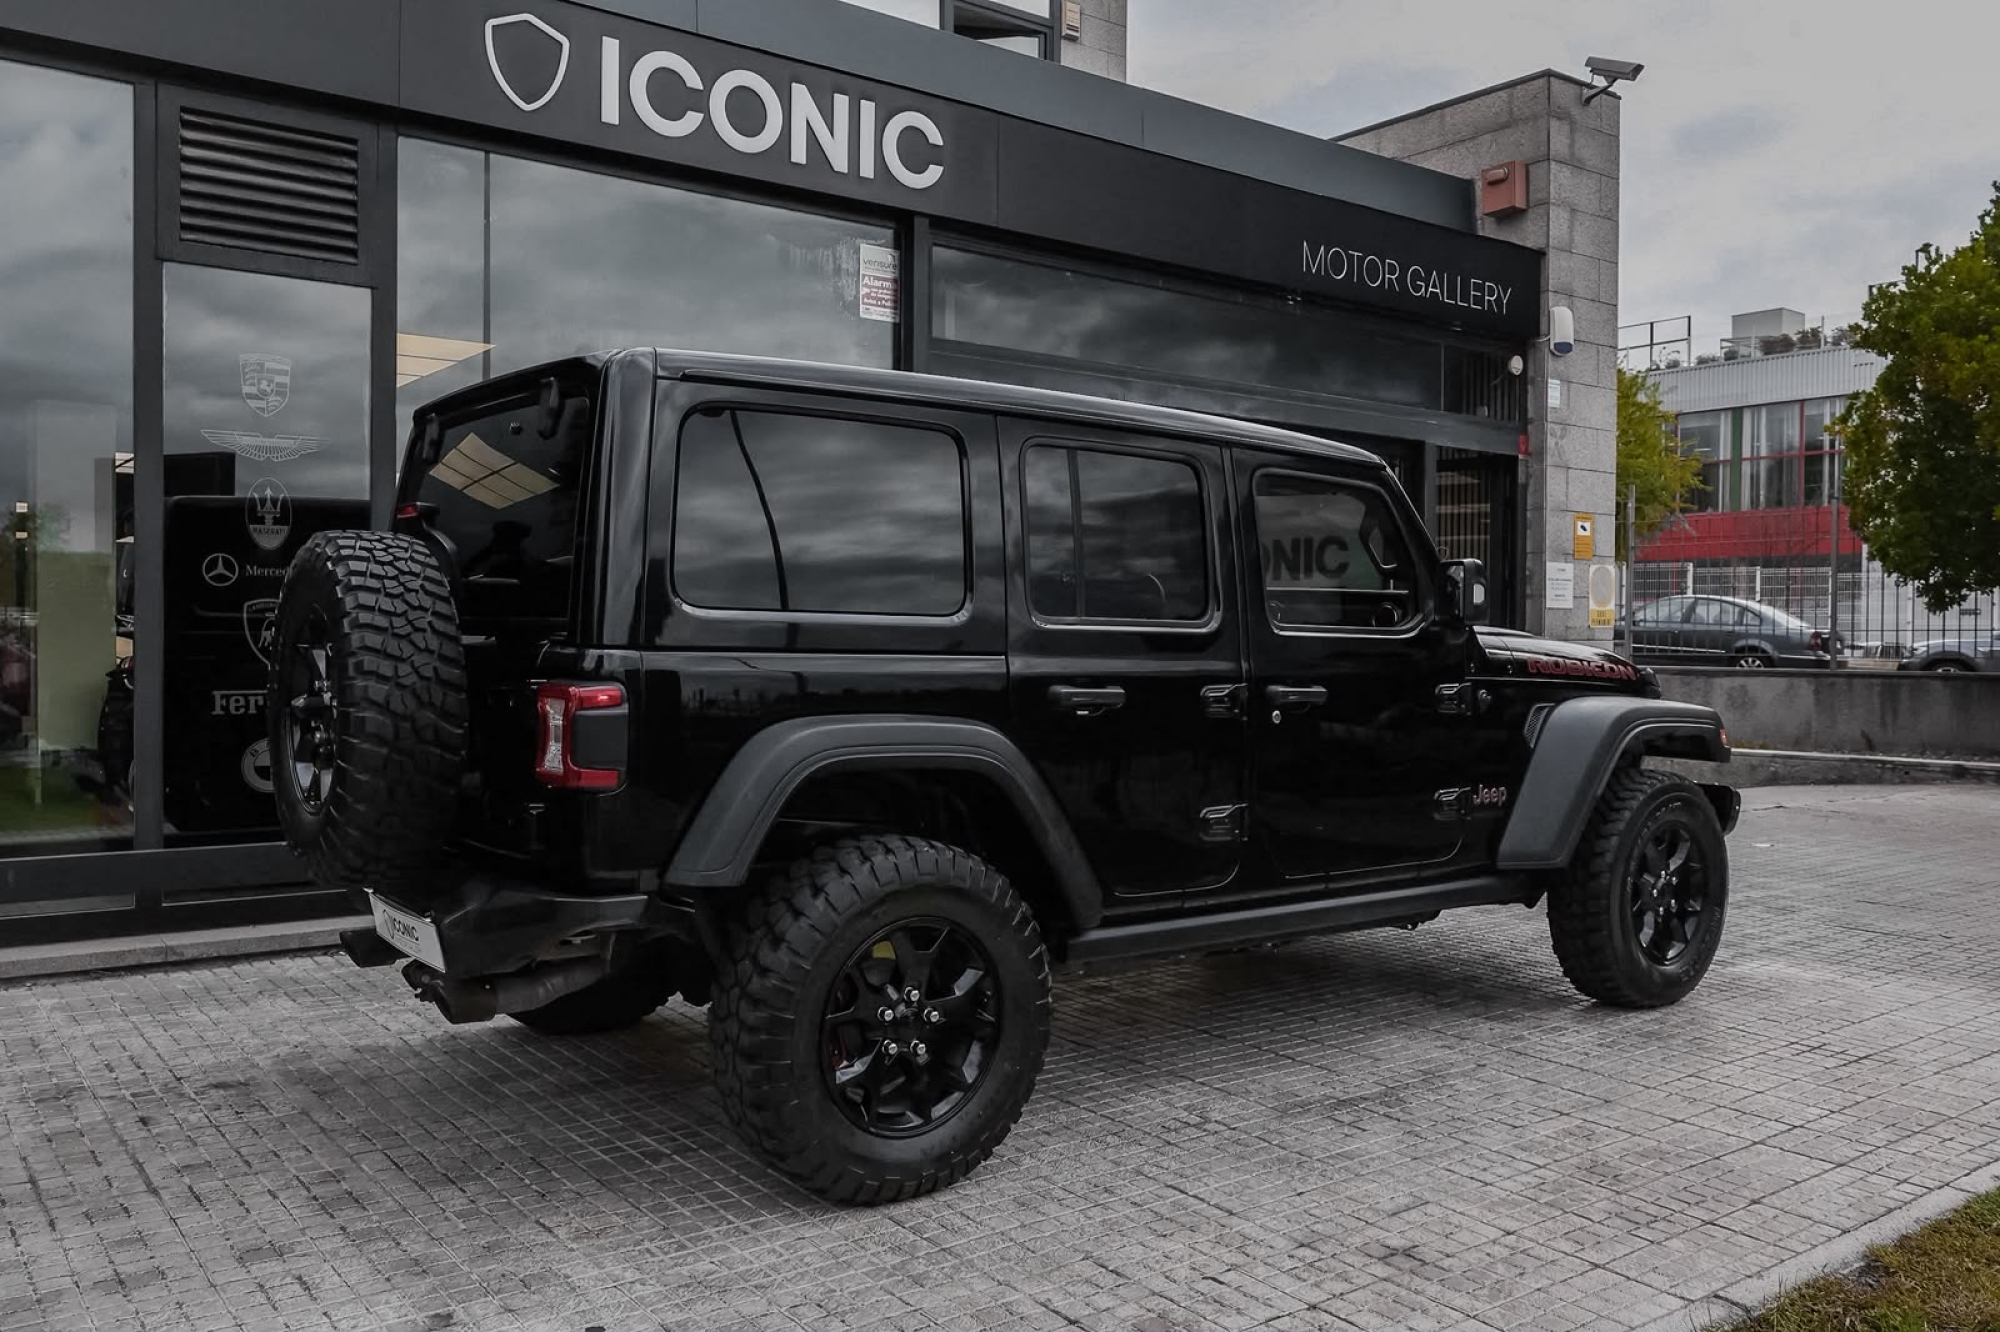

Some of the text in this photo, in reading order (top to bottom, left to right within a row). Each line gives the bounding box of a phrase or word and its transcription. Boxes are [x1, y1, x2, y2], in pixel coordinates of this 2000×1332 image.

[600, 35, 945, 190] ICONIC
[1302, 240, 1512, 315] MOTOR GALLERY
[245, 564, 290, 577] Merced
[1526, 657, 1638, 681] RUBICON
[1473, 784, 1507, 806] Jeep
